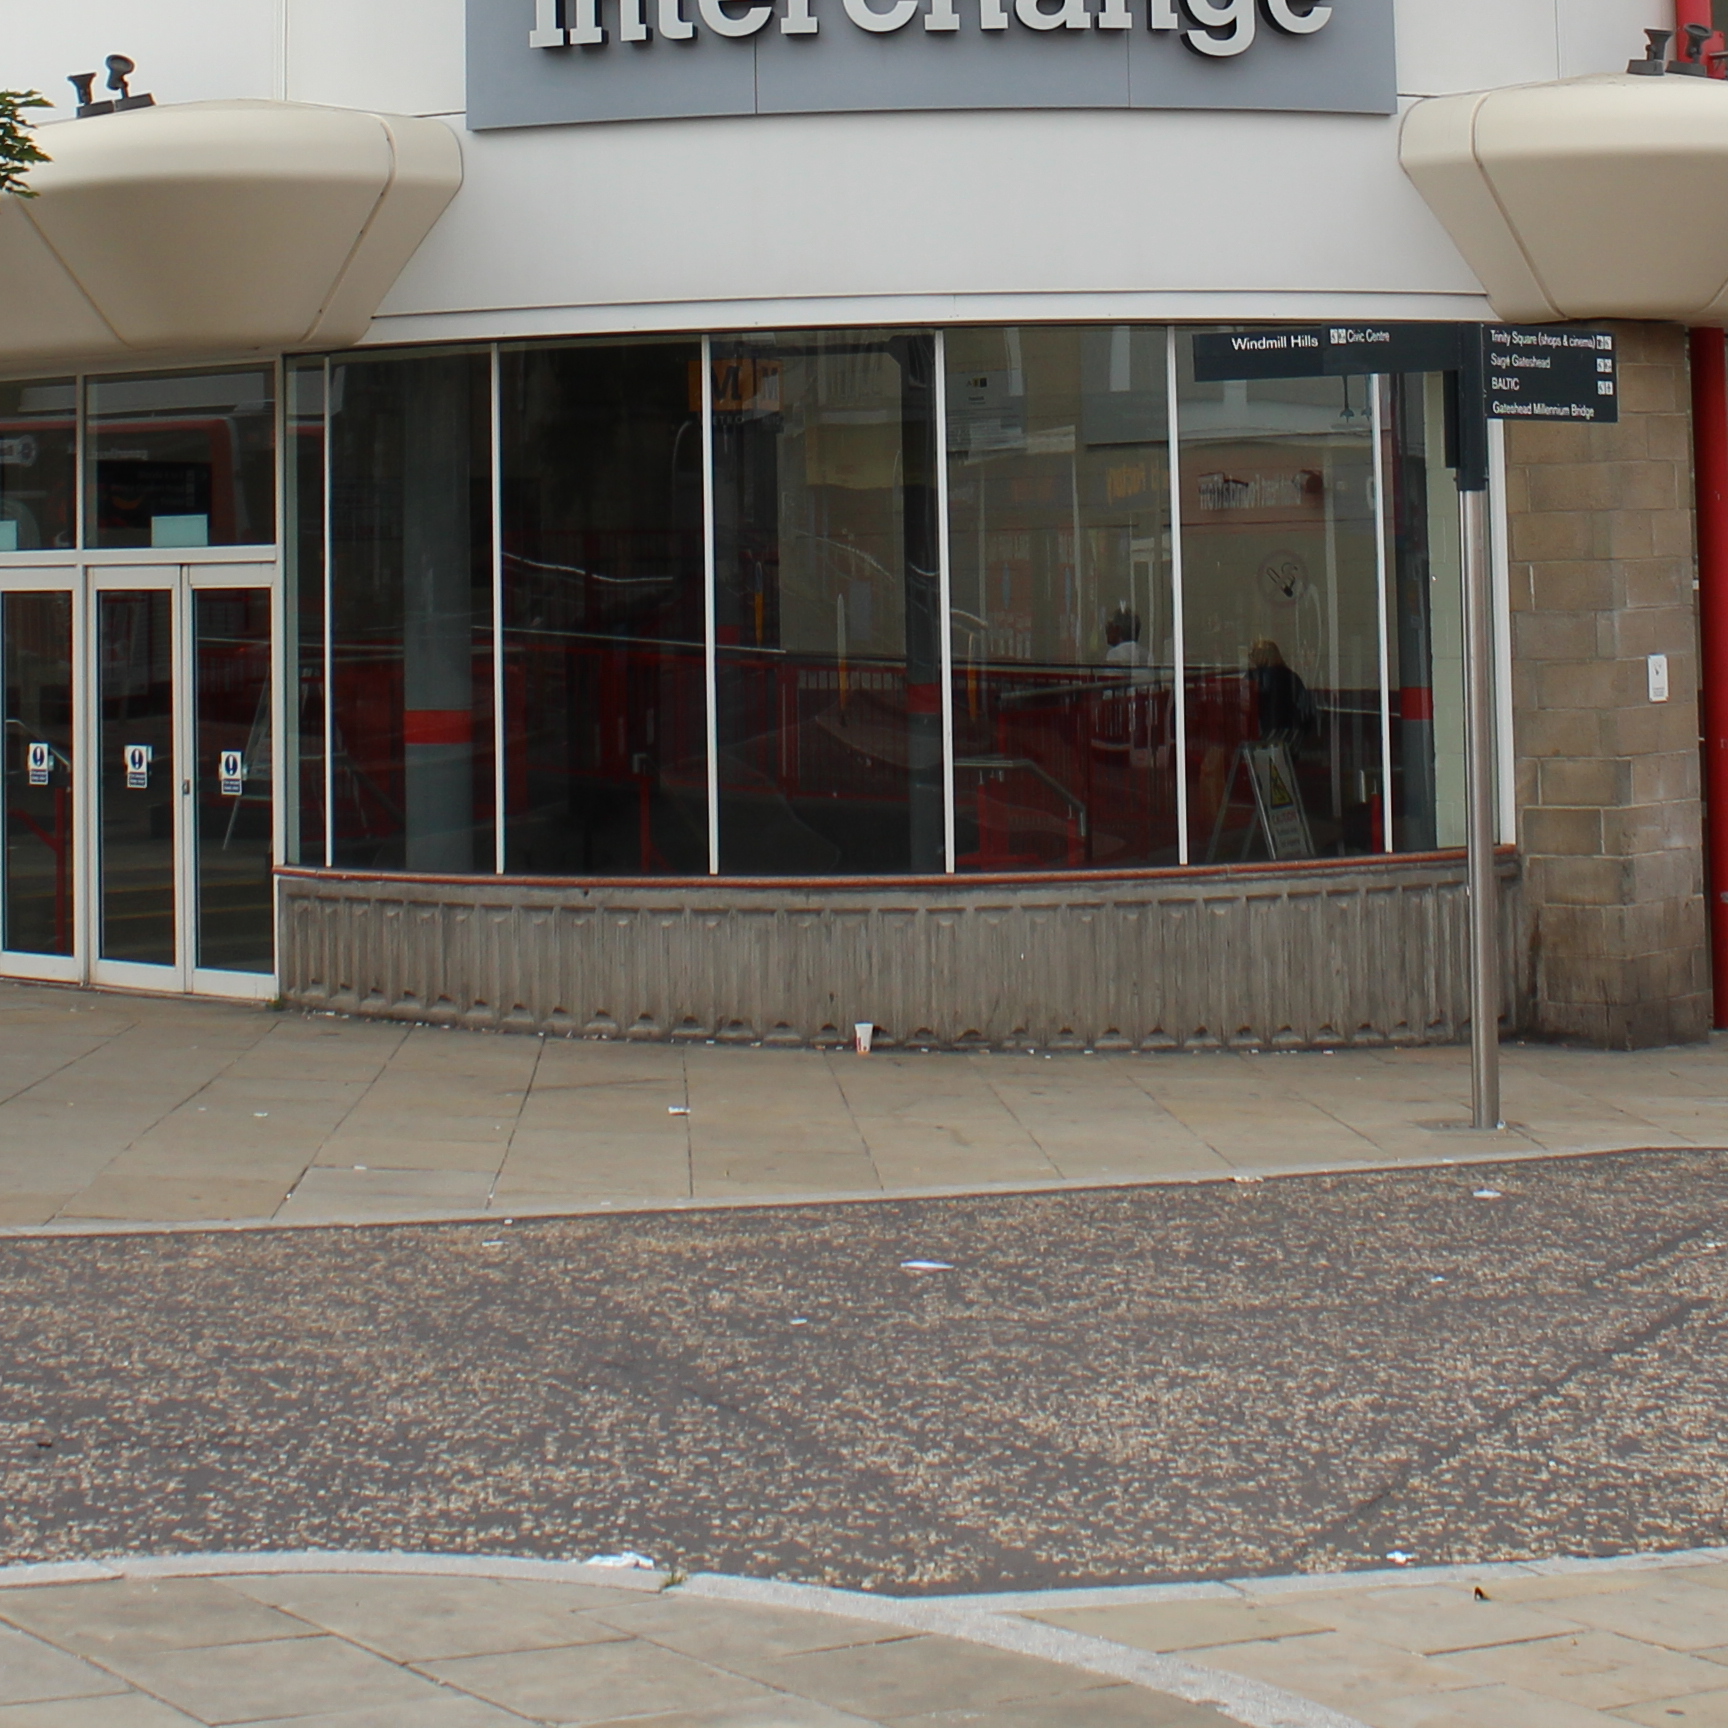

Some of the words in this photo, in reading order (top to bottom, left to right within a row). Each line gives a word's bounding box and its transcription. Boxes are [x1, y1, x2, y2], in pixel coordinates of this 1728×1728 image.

[1231, 336, 1287, 351] Windmill
[1291, 335, 1319, 348] Hills
[1347, 329, 1365, 343] Civic
[1365, 329, 1390, 343] Centre
[1490, 330, 1511, 346] Trinity
[1512, 331, 1537, 346] Square
[1538, 332, 1561, 349] (shops
[1562, 334, 1569, 347] &
[1570, 335, 1595, 350] cinema)
[1512, 354, 1551, 369] Gateshead
[1492, 377, 1520, 391] BALTIC
[1493, 401, 1532, 414] Gateshead
[1533, 403, 1570, 416] Millennium
[1571, 404, 1594, 420] Bridge
